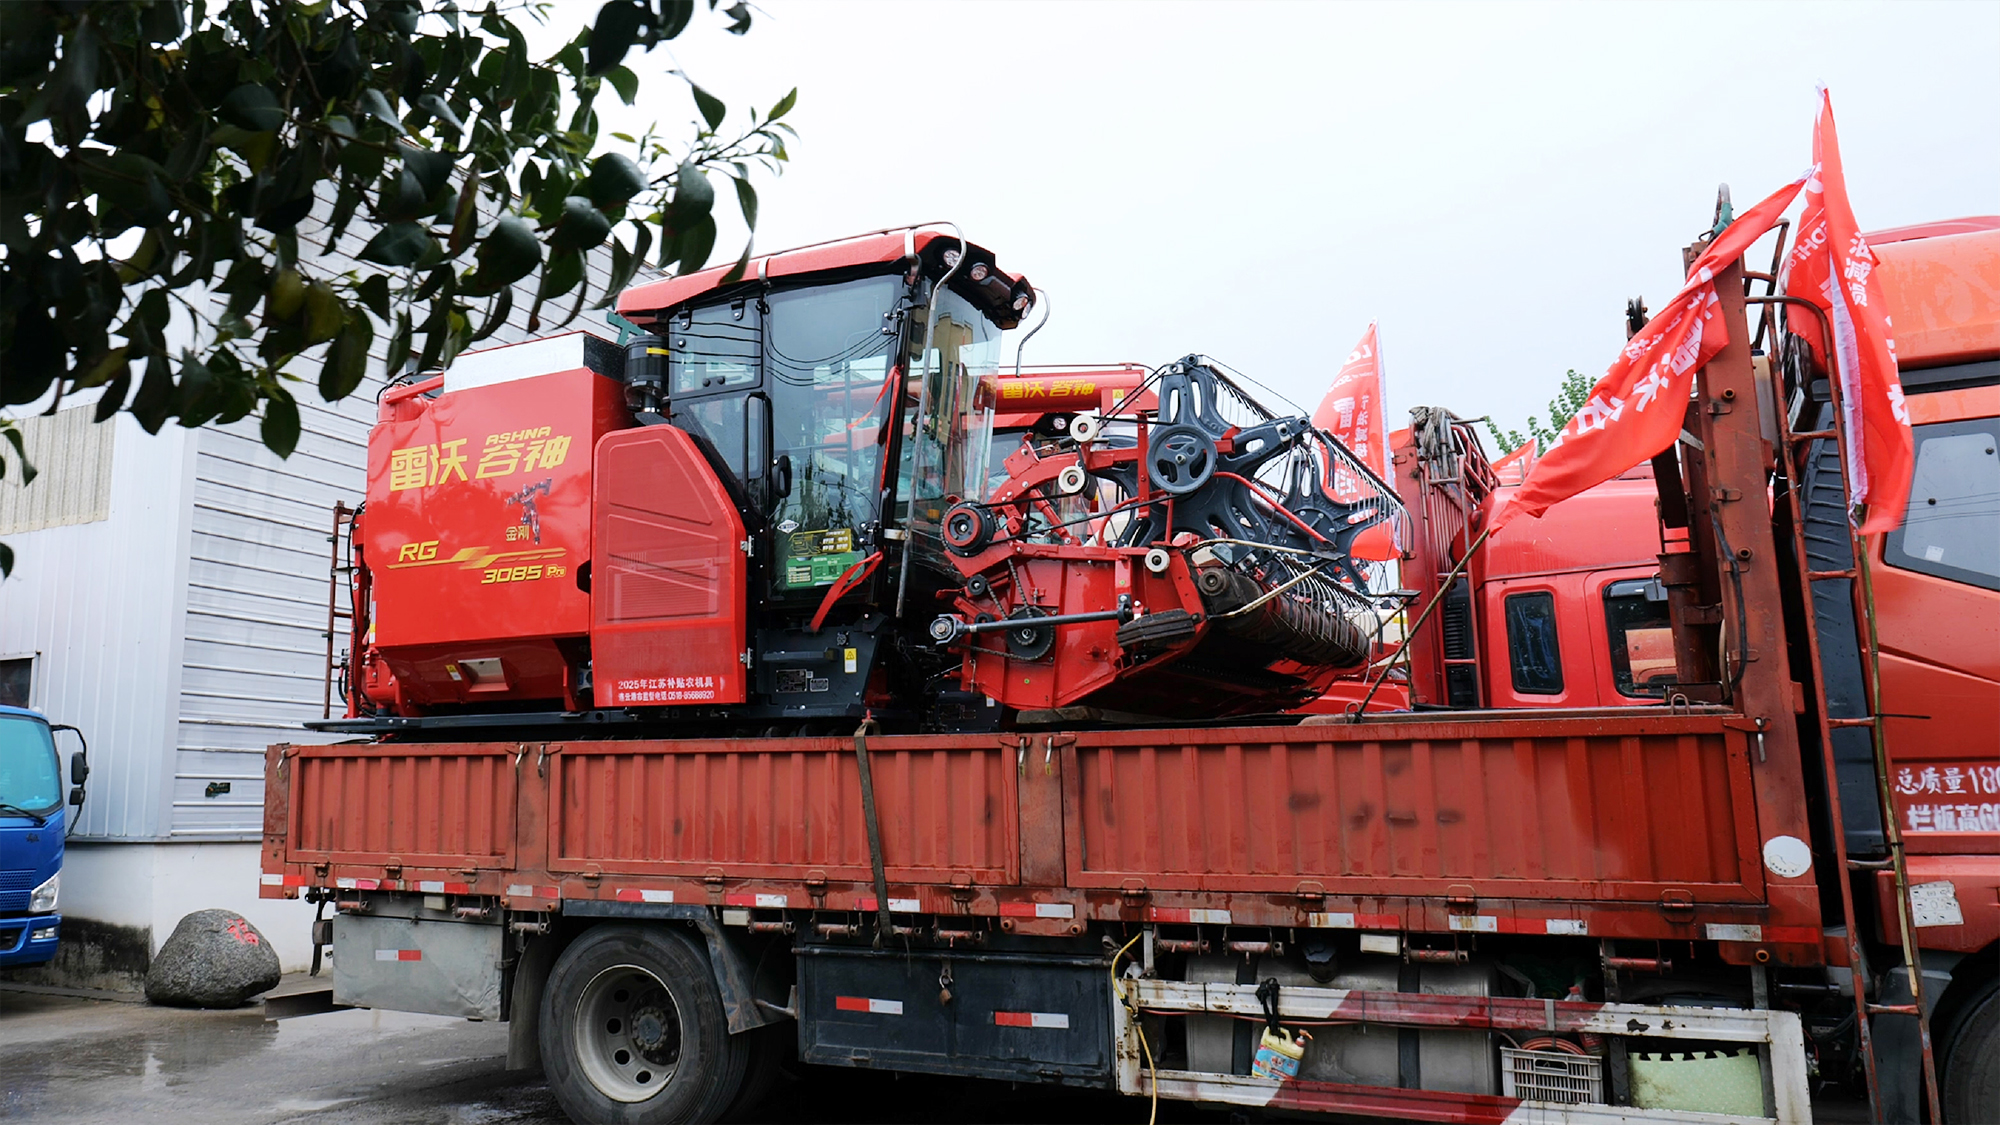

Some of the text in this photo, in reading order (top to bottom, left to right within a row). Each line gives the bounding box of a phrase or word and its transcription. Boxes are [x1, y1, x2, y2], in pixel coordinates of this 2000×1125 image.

[1002, 381, 1096, 399] 雷沃 谷神
[485, 426, 551, 446] ASHNA
[389, 435, 572, 492] 雷沃 谷神
[505, 524, 530, 542] 金刚
[398, 540, 440, 563] RG
[481, 564, 566, 584] 3085 Pro
[618, 676, 714, 690] 2025年江苏补贴农机具
